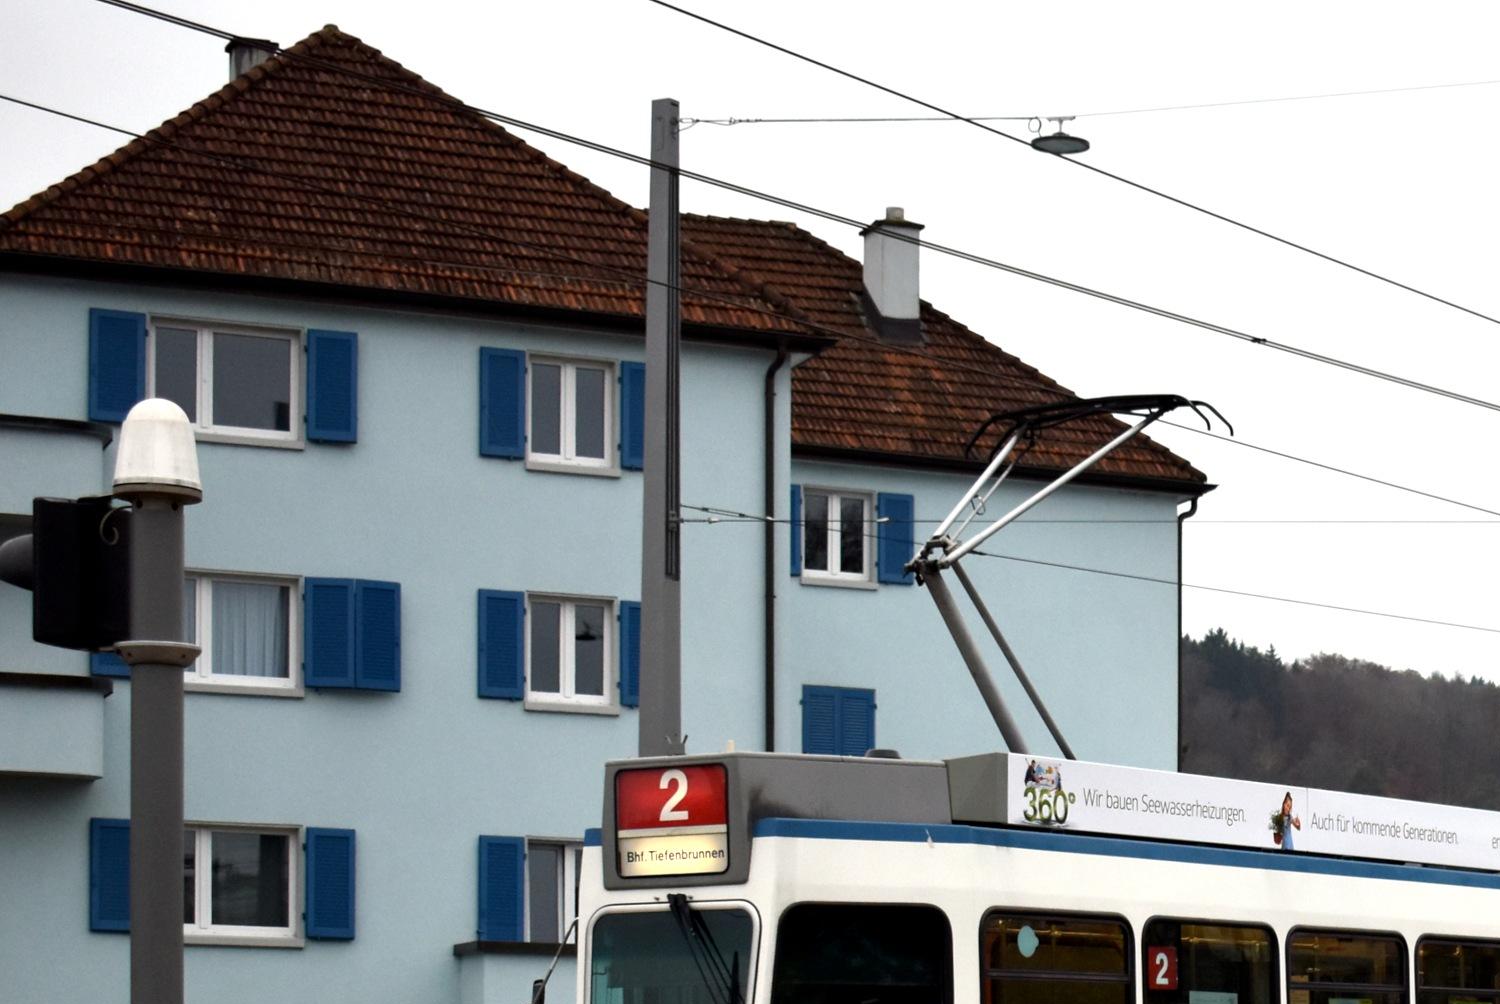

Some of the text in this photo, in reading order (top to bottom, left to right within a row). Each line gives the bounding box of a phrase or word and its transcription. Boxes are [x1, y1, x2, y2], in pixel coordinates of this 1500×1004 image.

[659, 768, 689, 822] 2
[1082, 788, 1247, 827] Wir bauen Seewasserheizungen.
[1310, 812, 1459, 845] Auch für kommende Generationen.
[627, 849, 725, 863] Bhf. Tiefenbrunnen
[1155, 952, 1169, 985] 2
